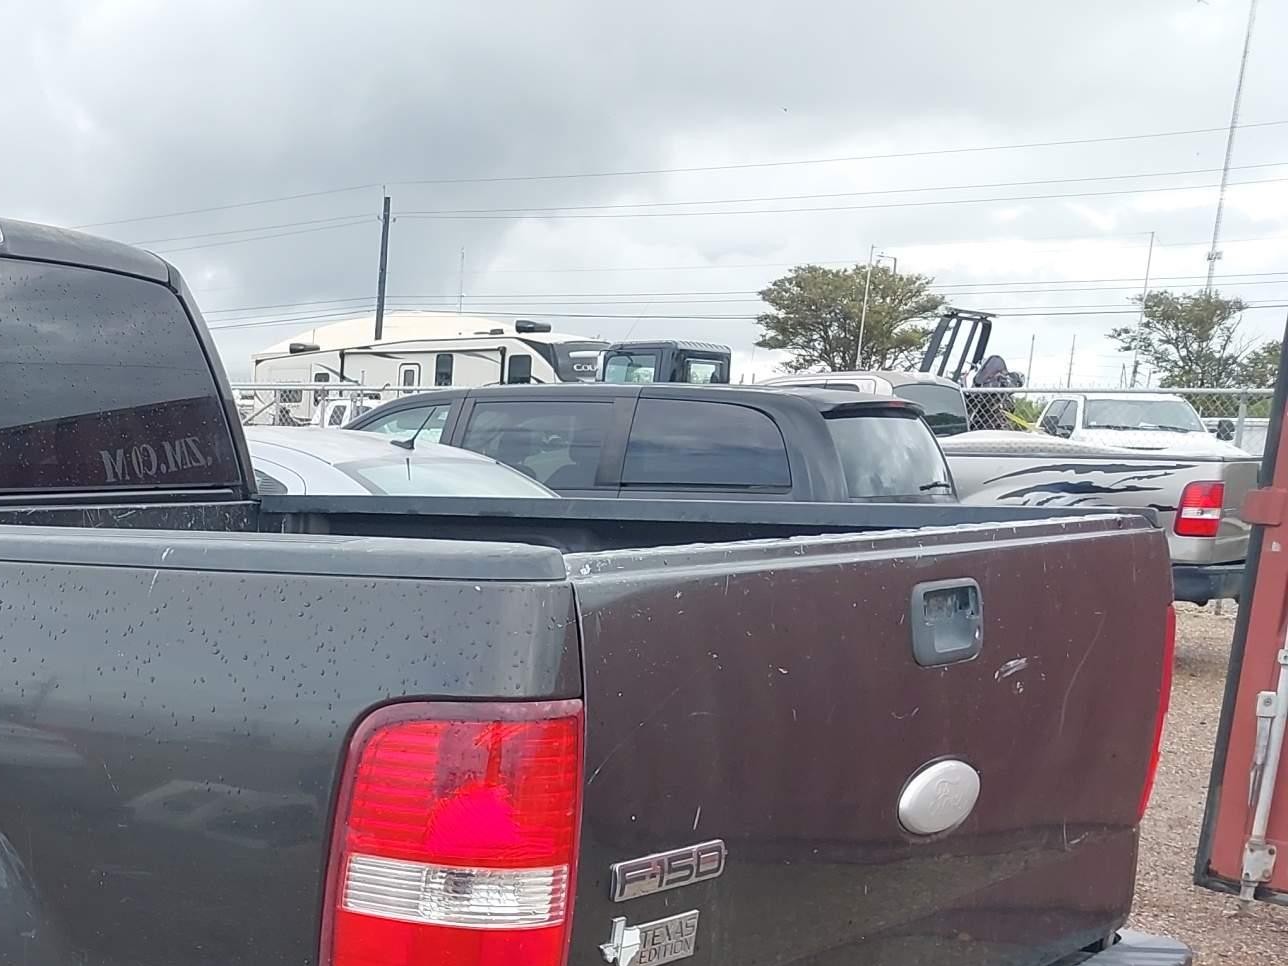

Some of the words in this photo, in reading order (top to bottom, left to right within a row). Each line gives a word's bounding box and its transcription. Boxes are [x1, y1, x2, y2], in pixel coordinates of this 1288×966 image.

[573, 363, 599, 372] COU
[641, 916, 697, 949] TEXAS
[638, 938, 692, 965] EDITION
